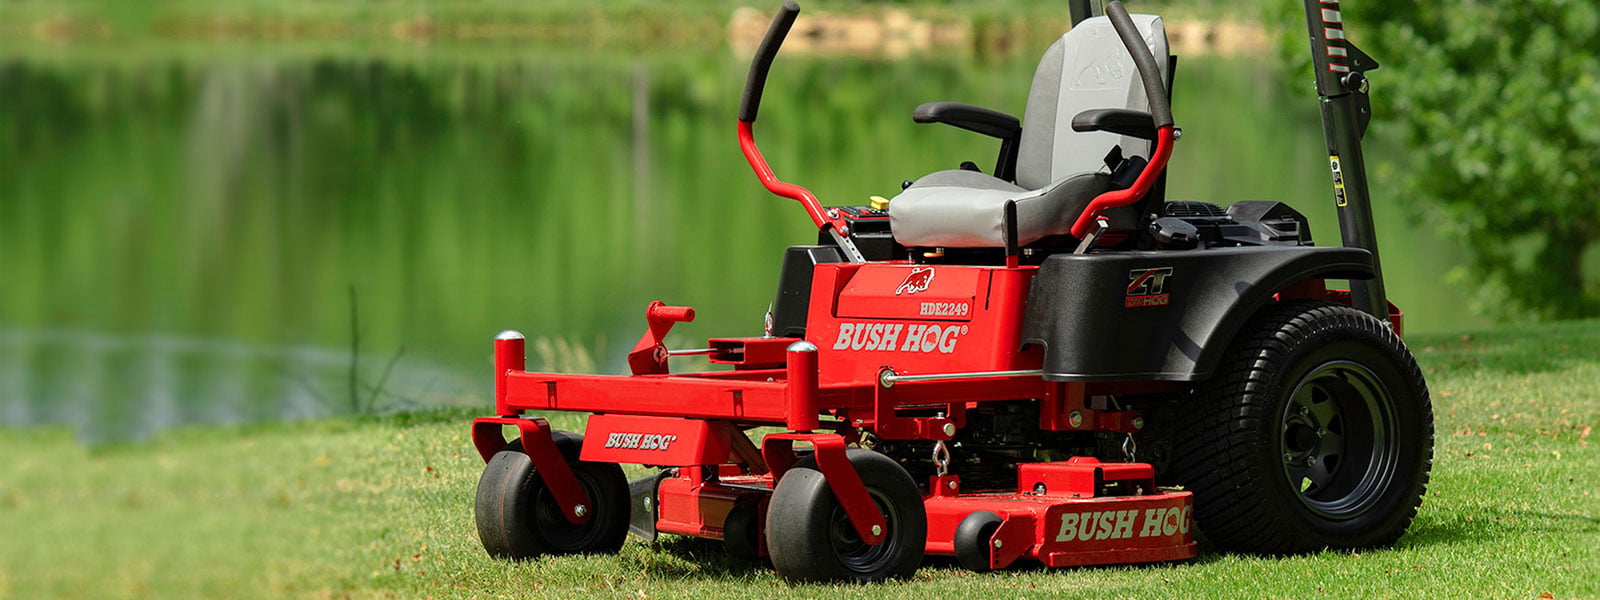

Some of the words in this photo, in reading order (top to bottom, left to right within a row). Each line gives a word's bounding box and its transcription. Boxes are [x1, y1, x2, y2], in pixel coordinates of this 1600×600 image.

[919, 302, 969, 316] HDE2249
[833, 323, 904, 351] BUSH
[605, 432, 643, 449] BUSH
[1055, 510, 1139, 542] BUSH
[1139, 504, 1191, 538] HOG
